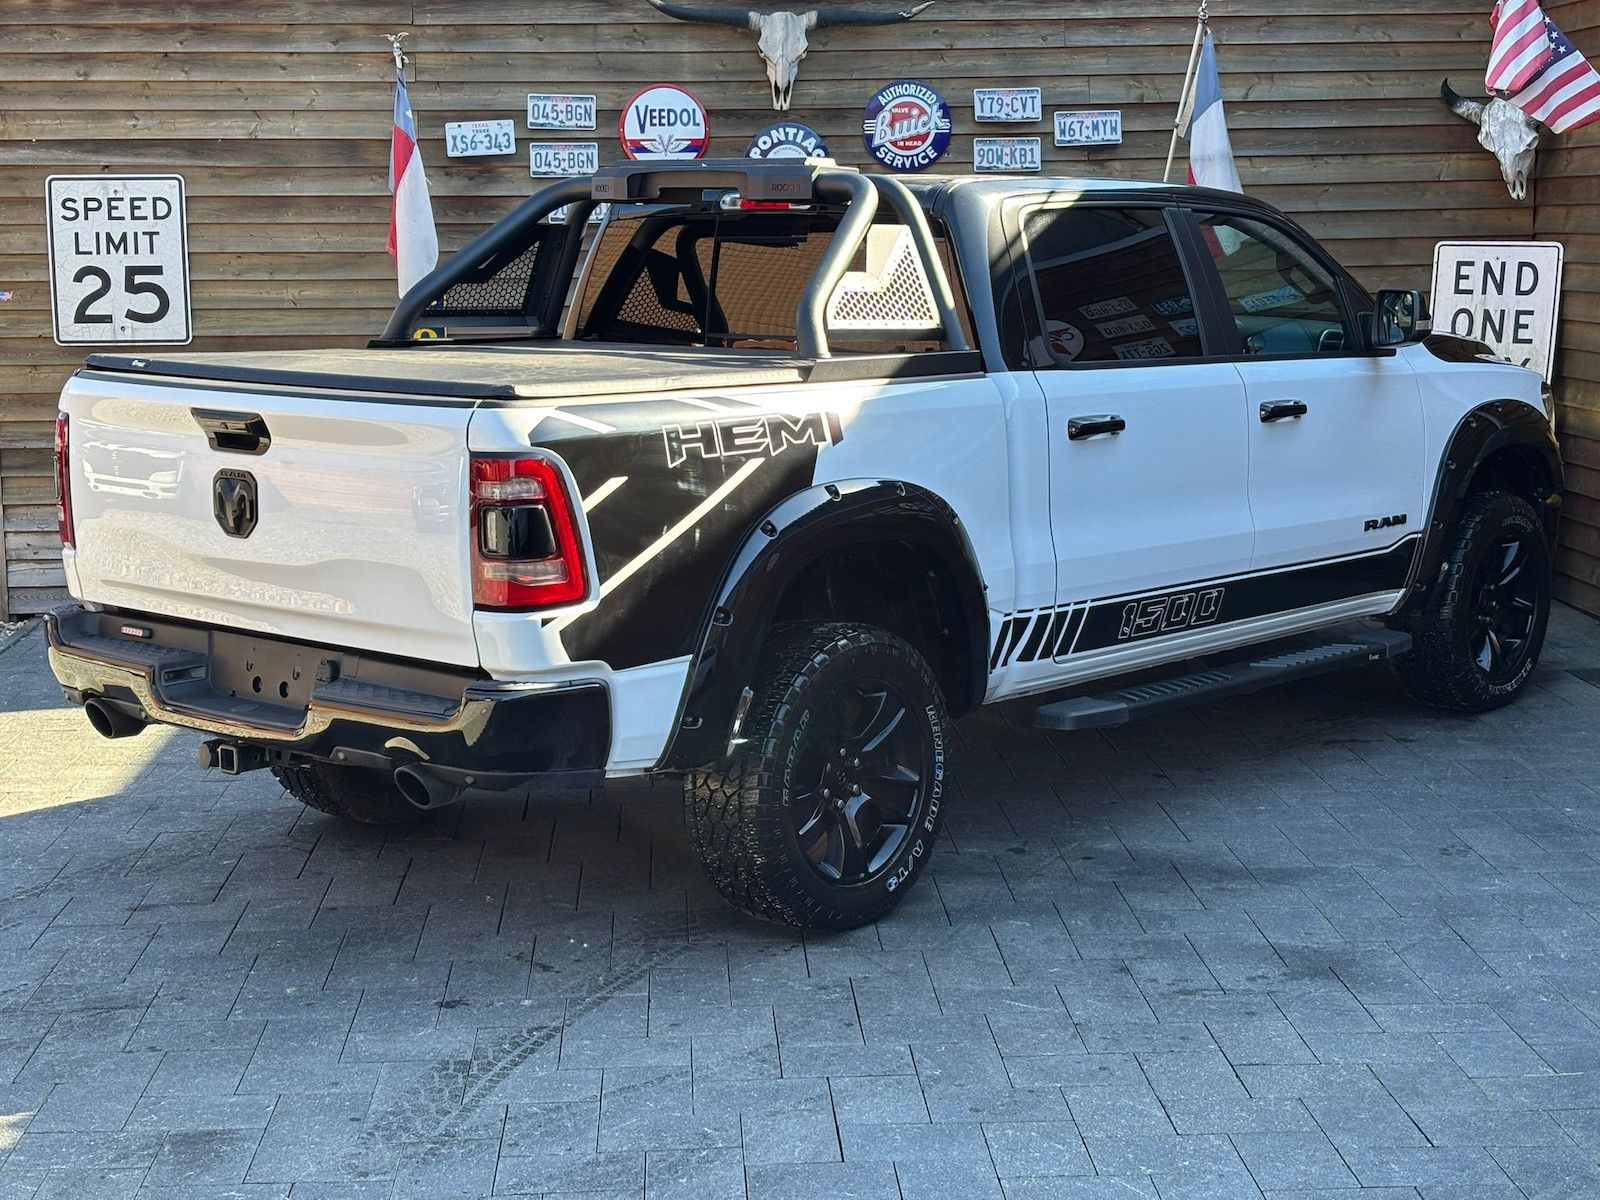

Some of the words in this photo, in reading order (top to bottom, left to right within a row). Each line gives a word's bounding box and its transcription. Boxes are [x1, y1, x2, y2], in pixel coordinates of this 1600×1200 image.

[878, 84, 937, 106] AUTHORIZED
[635, 105, 700, 134] VEEDOL
[872, 103, 944, 147] Buick
[876, 146, 938, 169] SERVICE
[60, 197, 172, 221] SPEED
[74, 231, 160, 255] LIMIT
[72, 265, 170, 324] 25
[1453, 261, 1539, 296] END
[1451, 308, 1535, 345] ONE
[661, 412, 844, 469] HEMI
[1364, 514, 1407, 531] RAM
[1118, 588, 1225, 639] 1500
[925, 705, 944, 832] RENEGADE
